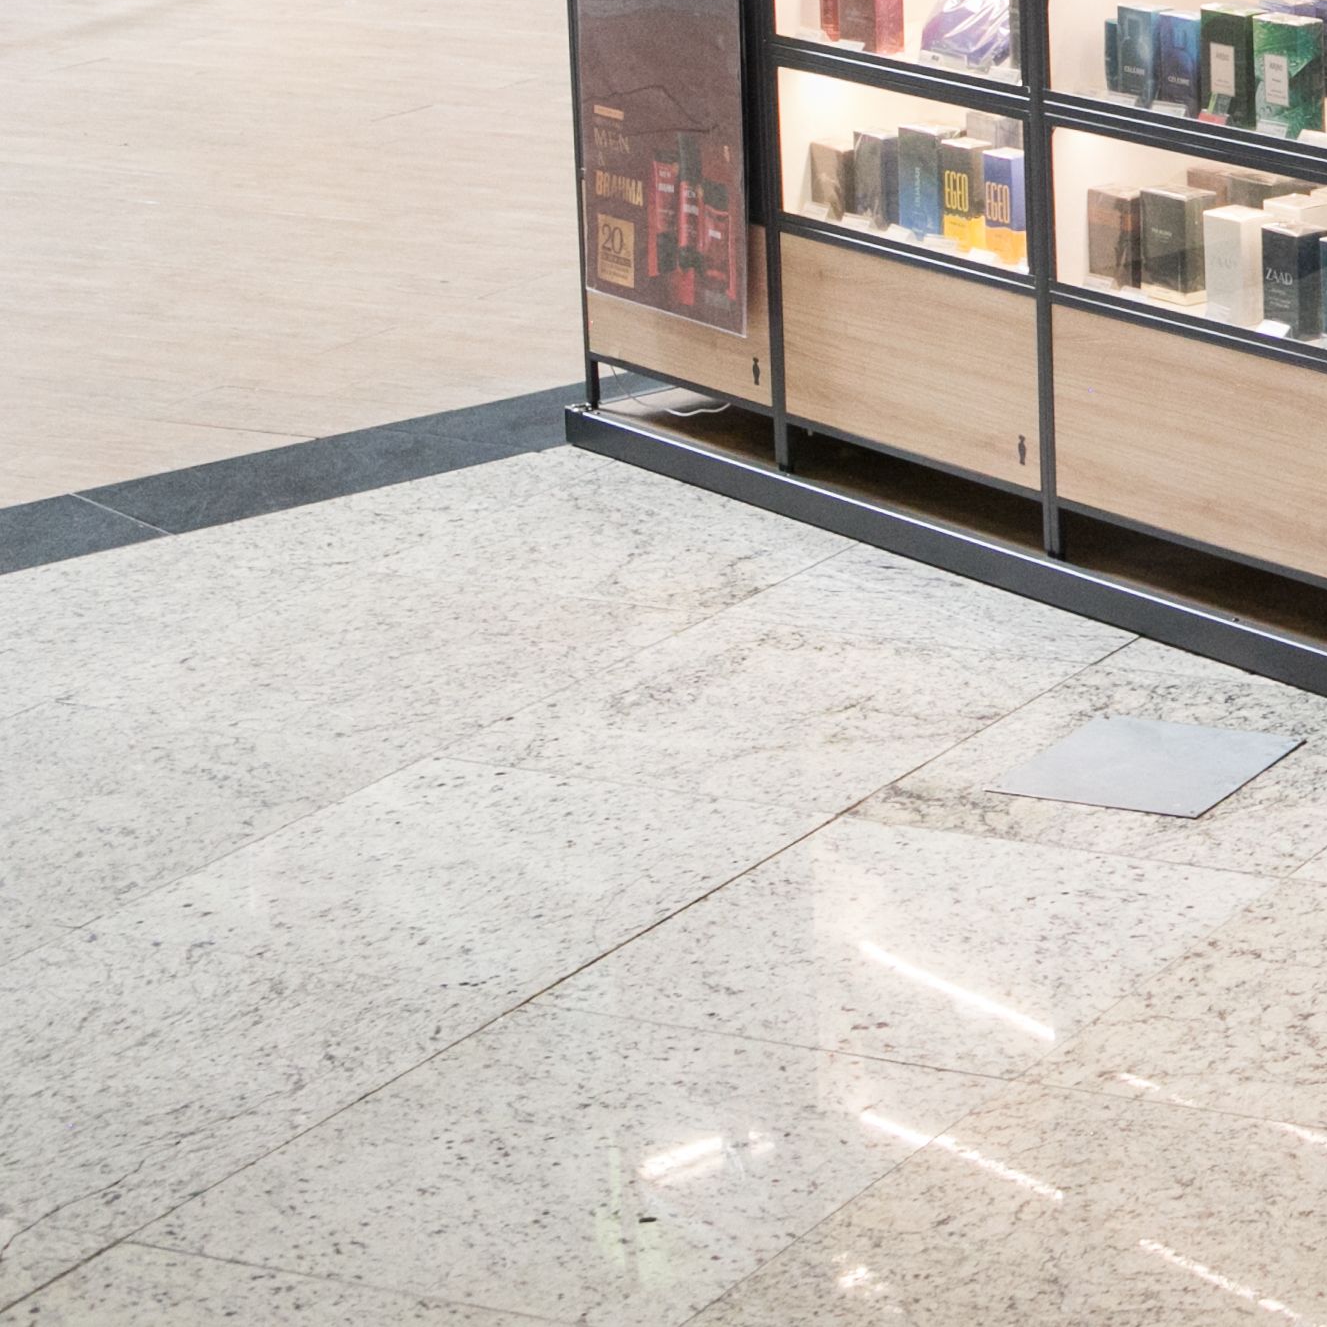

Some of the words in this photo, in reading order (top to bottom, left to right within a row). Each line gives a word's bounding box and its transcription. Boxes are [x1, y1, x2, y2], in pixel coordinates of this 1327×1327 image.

[595, 170, 644, 207] BRAHMA
[944, 169, 969, 213] EGEO
[985, 181, 1010, 224] EGEO
[1265, 267, 1294, 286] ZAAD
